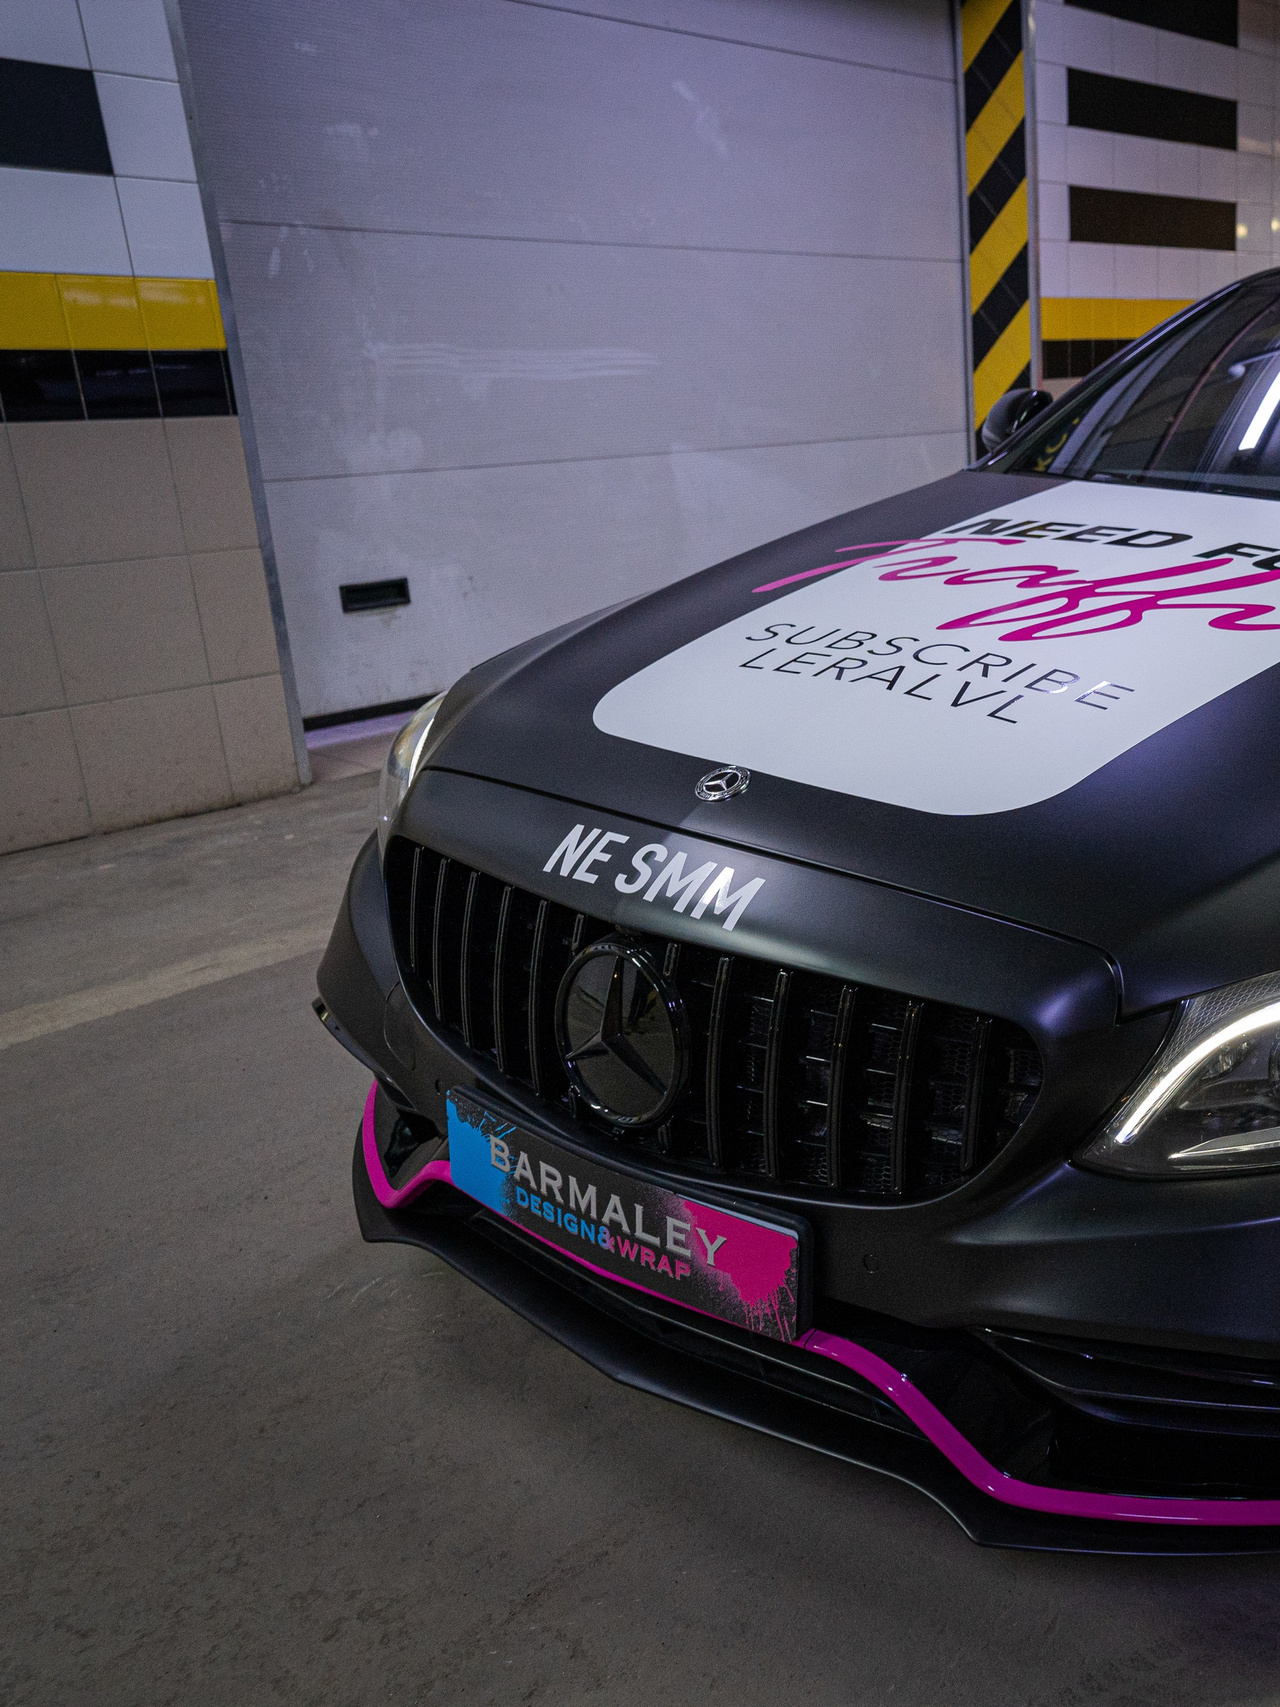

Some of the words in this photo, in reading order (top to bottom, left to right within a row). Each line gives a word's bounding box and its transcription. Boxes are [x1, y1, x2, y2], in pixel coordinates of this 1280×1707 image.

[943, 518, 1193, 548] NEED
[738, 648, 1026, 724] LERALVL
[746, 623, 1135, 711] SUBSCRIBE
[543, 823, 630, 884] NE
[614, 843, 766, 931] SMM
[489, 1135, 727, 1267] BARMALEY
[514, 1186, 691, 1280] DESIGN&WRAP
